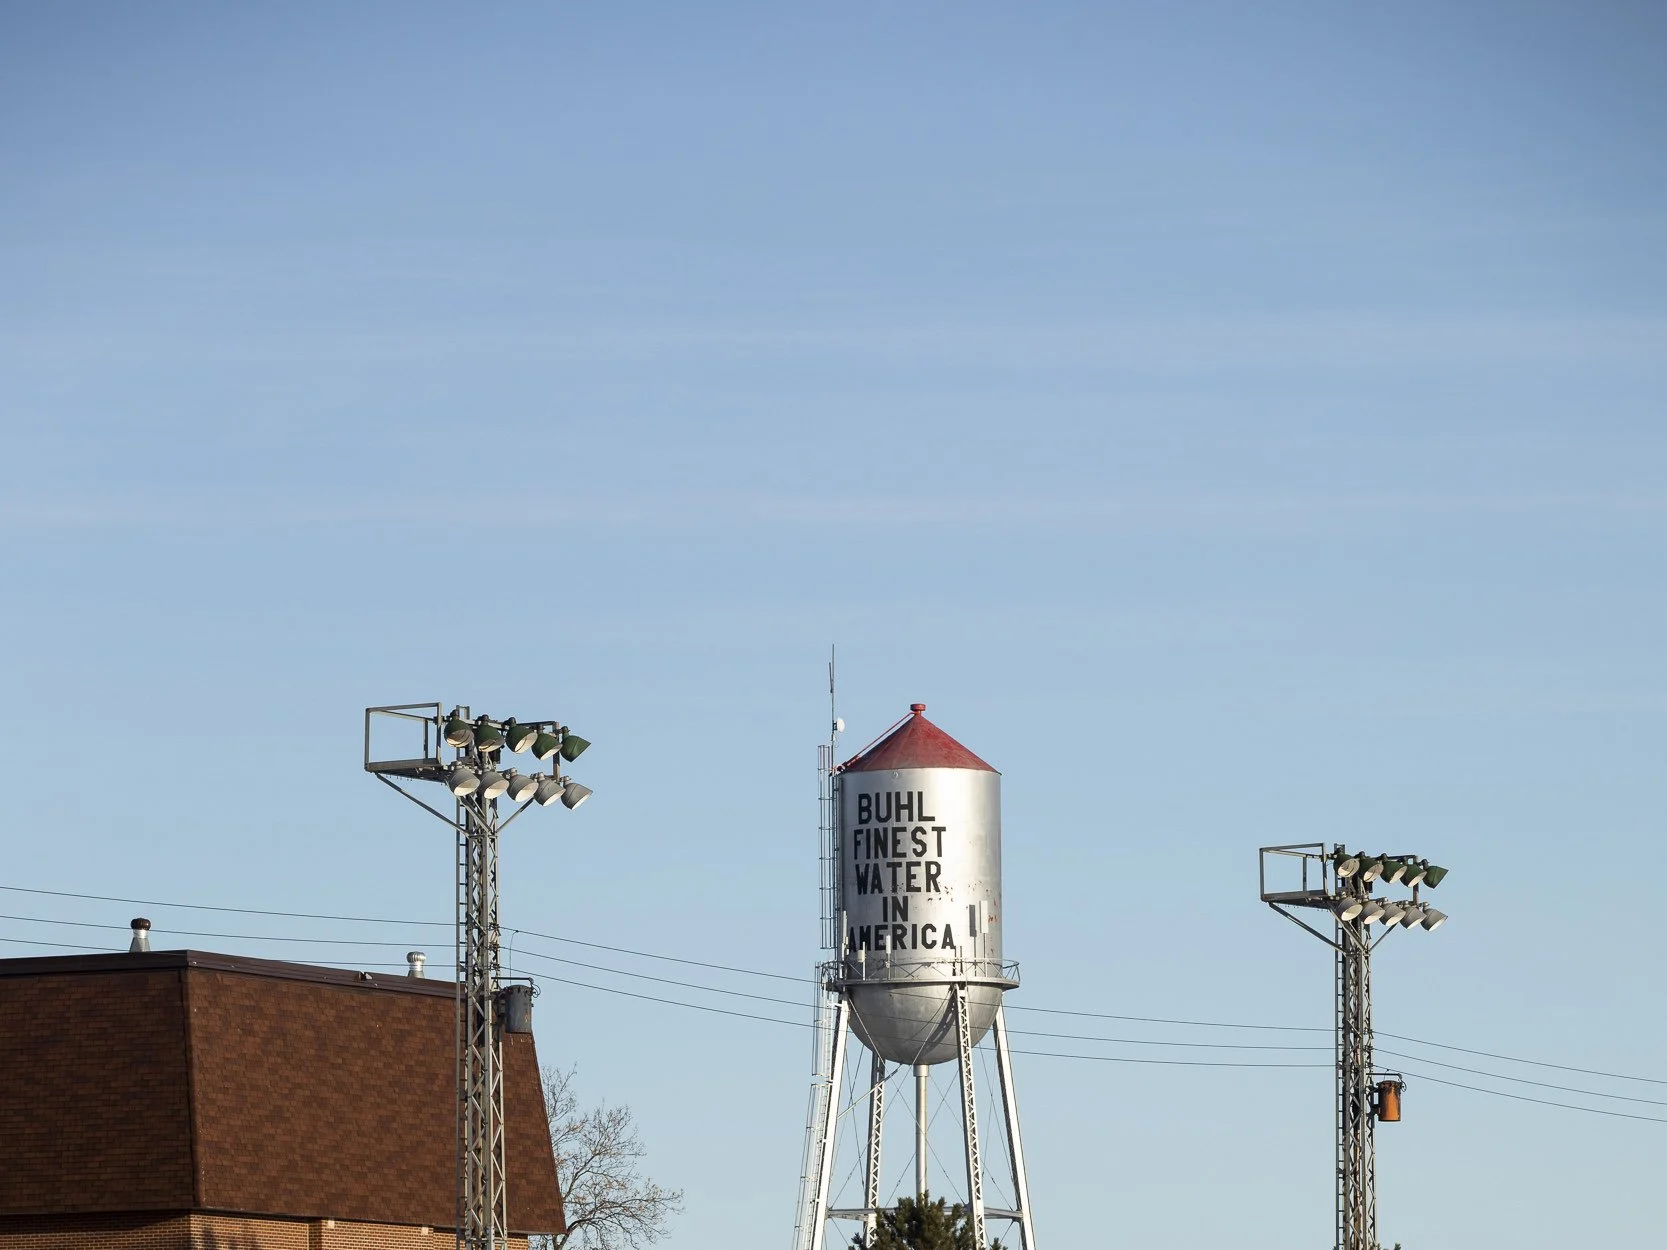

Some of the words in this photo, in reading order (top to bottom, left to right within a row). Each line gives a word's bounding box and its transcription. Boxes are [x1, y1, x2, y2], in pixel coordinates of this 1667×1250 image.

[858, 791, 936, 824] BUHL
[853, 826, 947, 860] FINEST
[855, 861, 942, 895] WATER
[882, 896, 909, 922] IN
[849, 923, 956, 952] AMERICA
